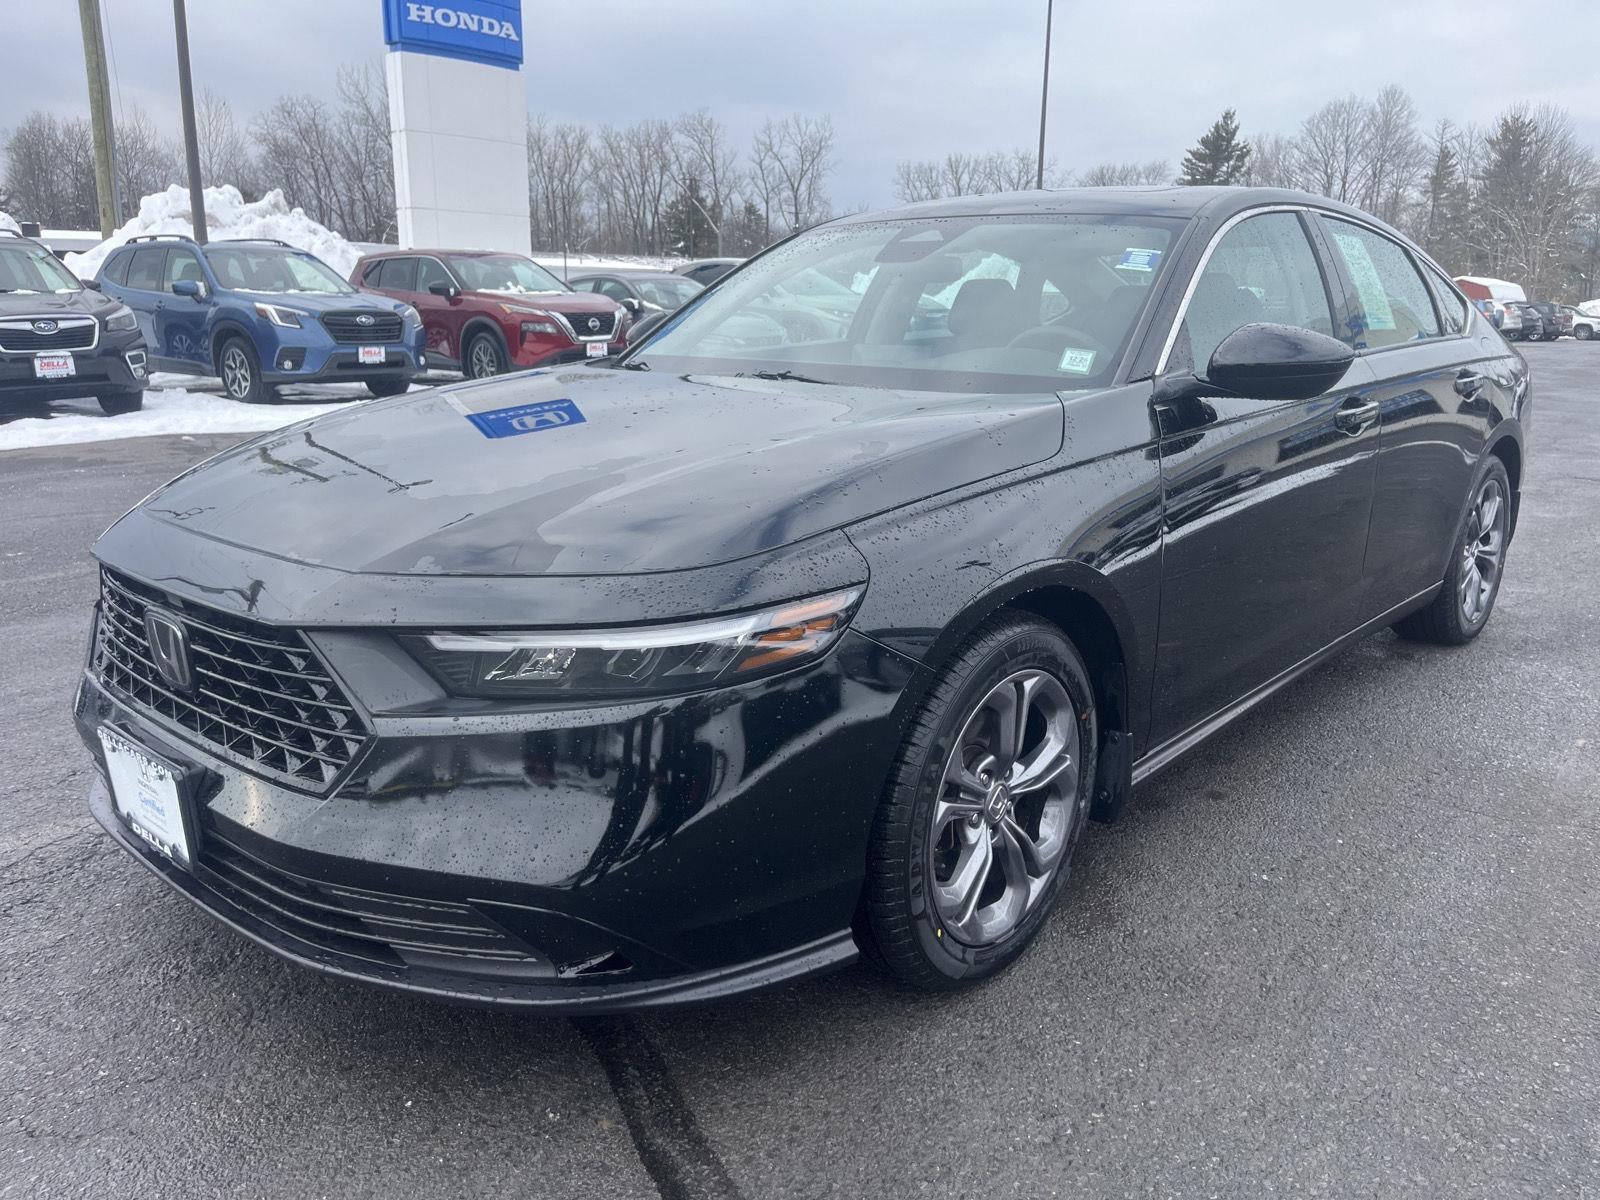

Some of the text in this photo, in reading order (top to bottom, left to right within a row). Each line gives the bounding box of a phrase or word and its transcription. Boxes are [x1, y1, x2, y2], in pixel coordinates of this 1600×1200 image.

[406, 3, 519, 41] HONDA
[40, 358, 69, 370] DELLA
[133, 821, 173, 858] DELLA
